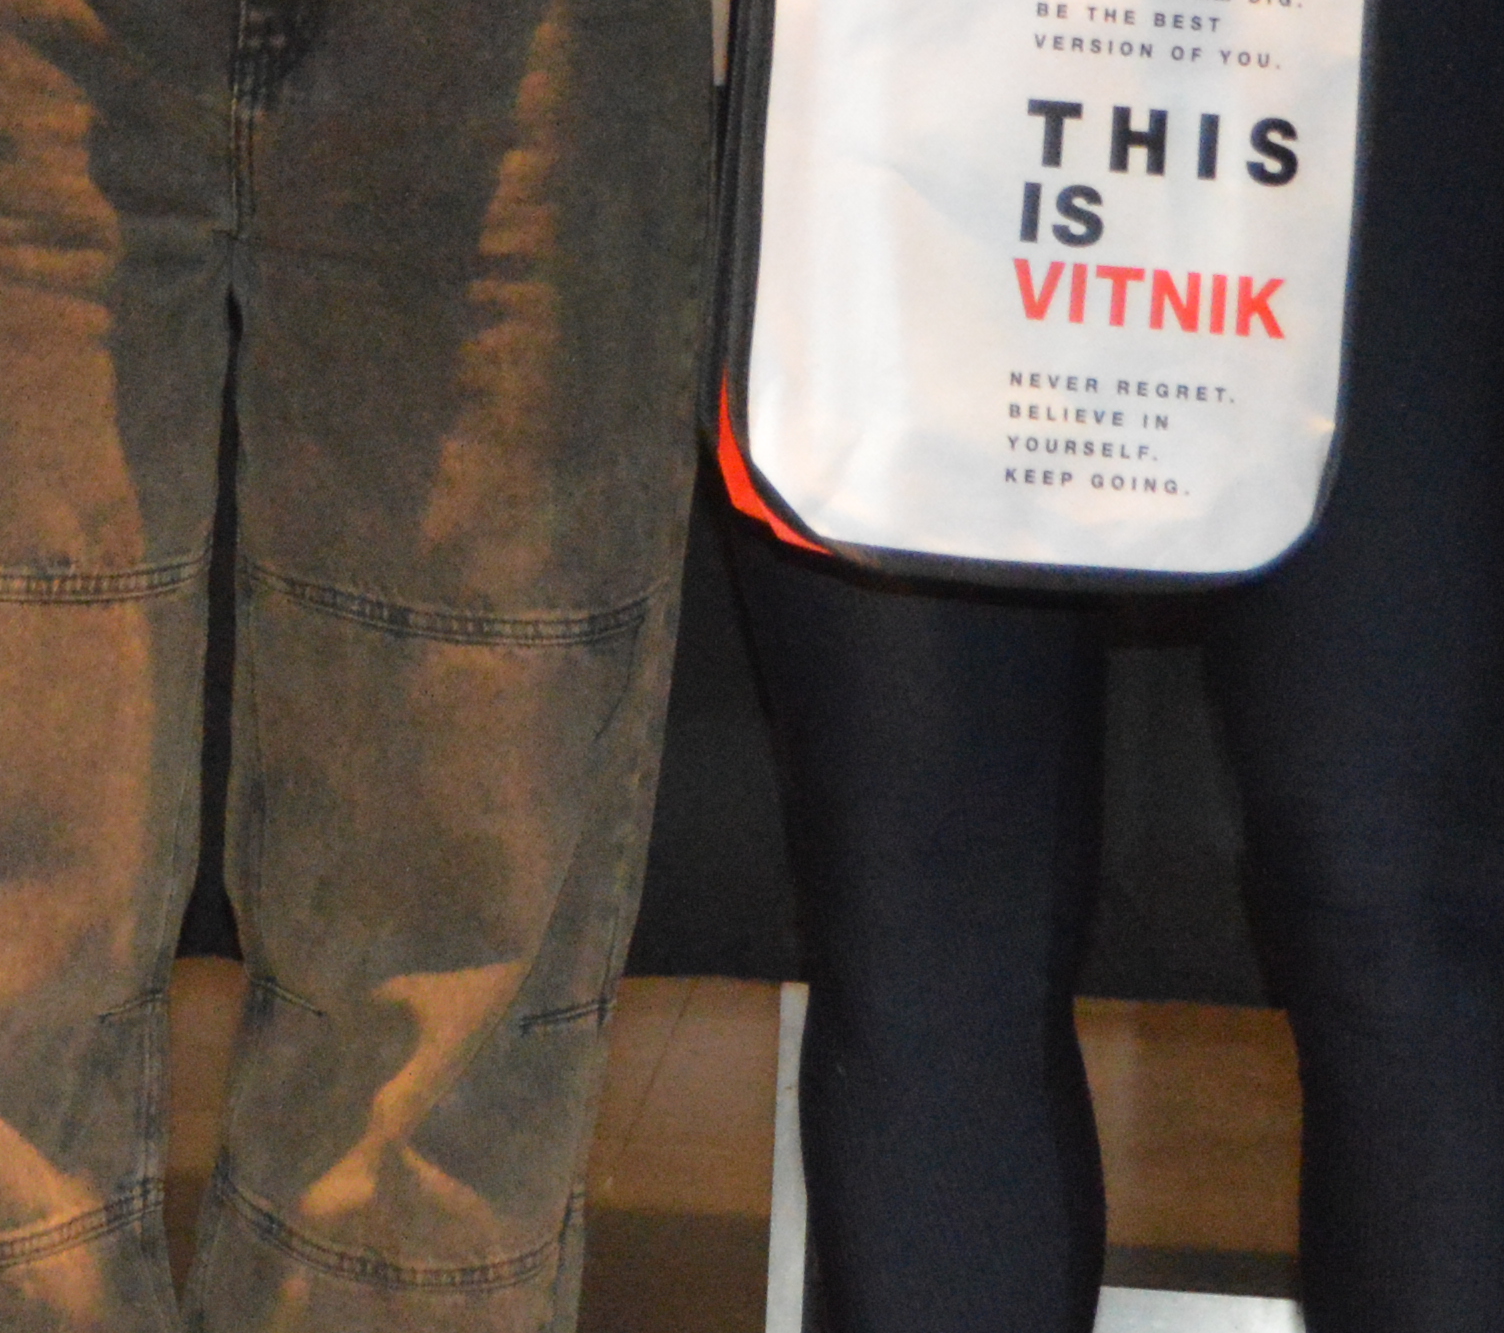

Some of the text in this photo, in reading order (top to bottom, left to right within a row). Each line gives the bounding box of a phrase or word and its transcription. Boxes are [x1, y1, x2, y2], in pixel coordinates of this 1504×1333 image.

[1036, 1, 1220, 32] BE THE BEST
[1034, 34, 1281, 70] VERSION OF YOU.
[1028, 99, 1299, 187] THIS
[1019, 181, 1104, 248] IS
[1014, 258, 1285, 340] VITNIK
[1009, 371, 1235, 404] NEVER REGRET.
[1008, 403, 1169, 430] BELIEVE IN
[1005, 434, 1161, 462] YOURSELF.
[1004, 467, 1189, 496] KEEP GOING.
